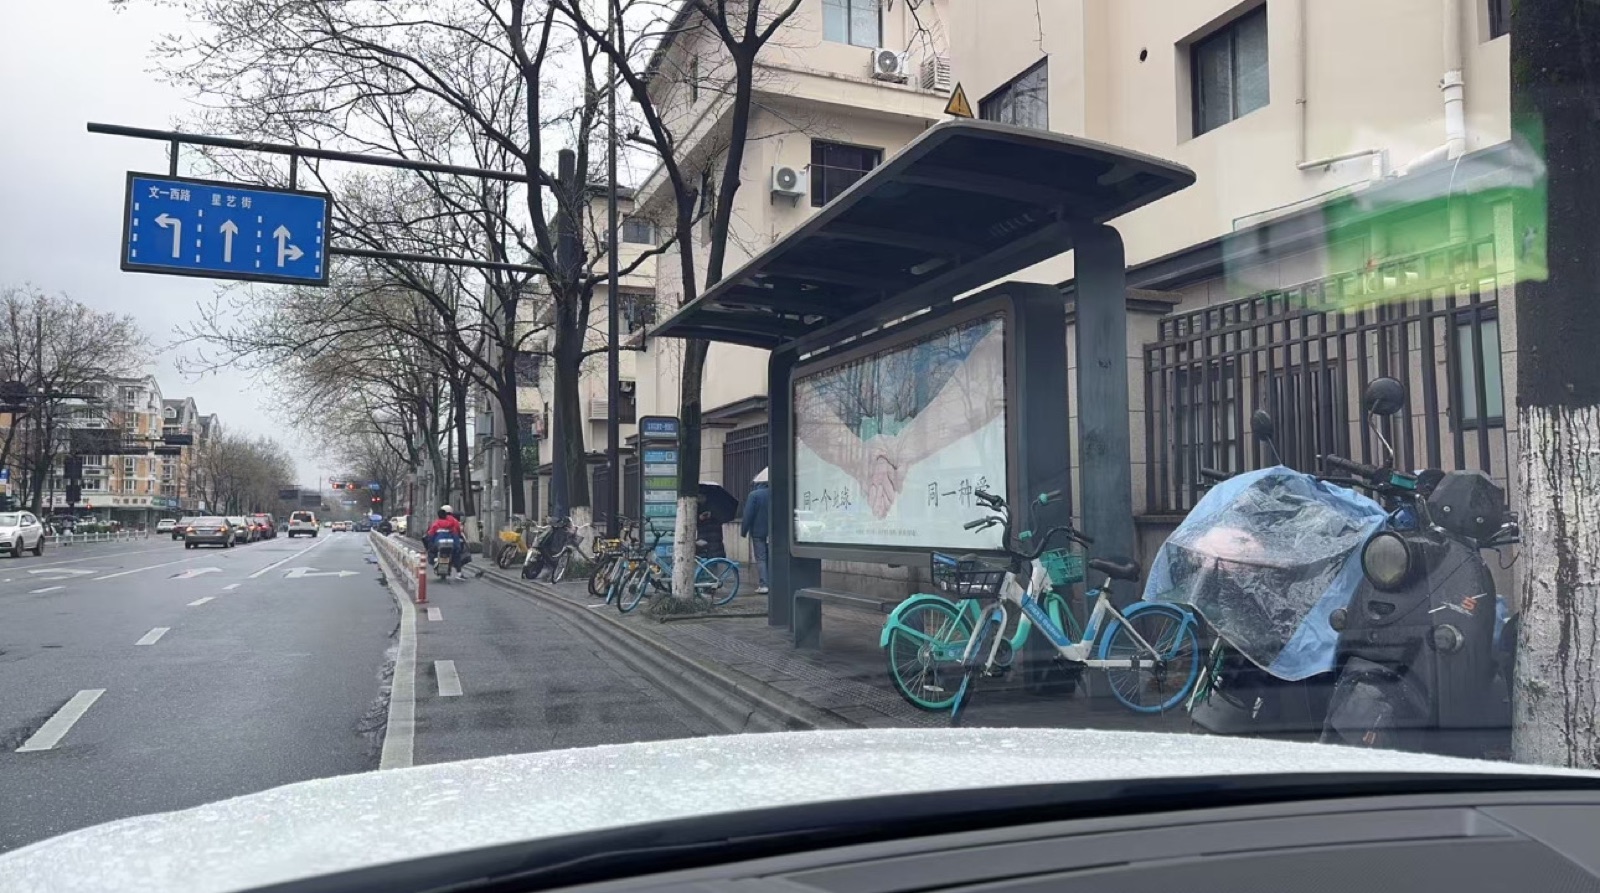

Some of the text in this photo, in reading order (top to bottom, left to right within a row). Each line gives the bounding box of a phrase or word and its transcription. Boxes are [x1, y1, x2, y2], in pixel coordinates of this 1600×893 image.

[149, 185, 191, 202] 文一西路
[211, 193, 252, 209] 星艺街
